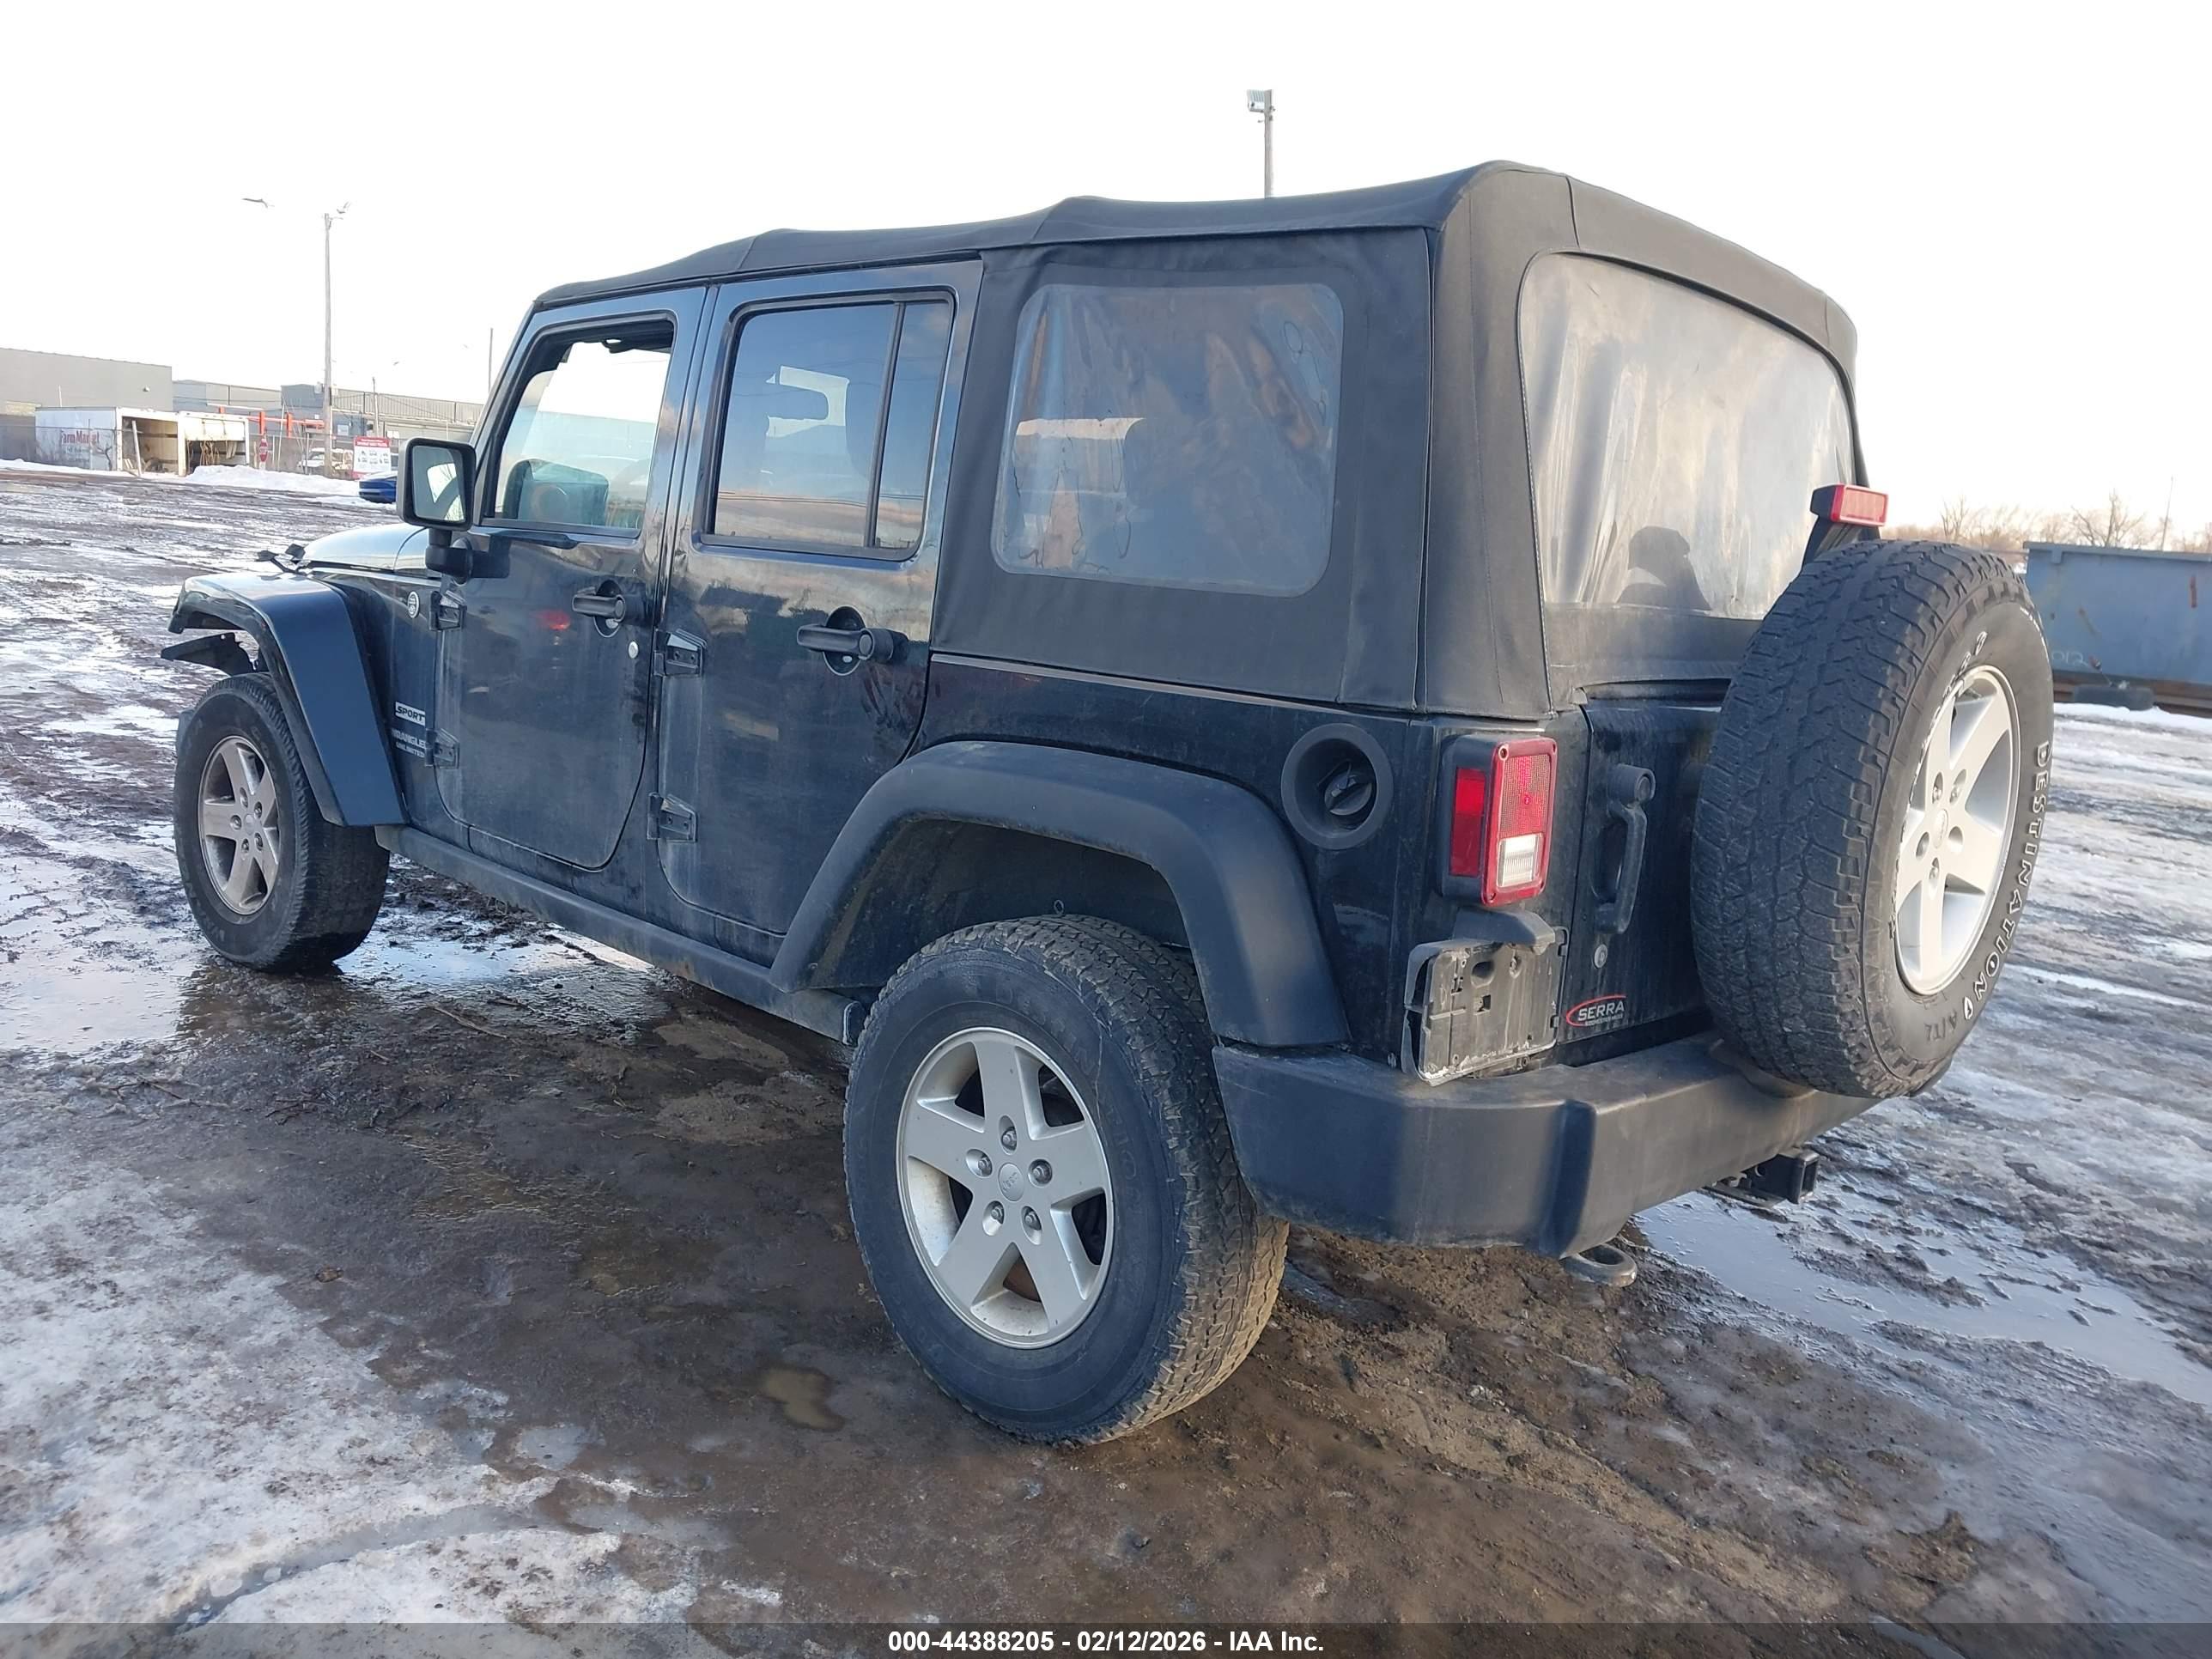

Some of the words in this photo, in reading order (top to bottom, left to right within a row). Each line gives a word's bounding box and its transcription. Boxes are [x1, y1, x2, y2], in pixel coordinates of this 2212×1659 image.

[397, 705, 425, 722] SPORT
[1973, 742, 2051, 1003] DESTINATION
[1577, 1000, 1625, 1021] SERRA
